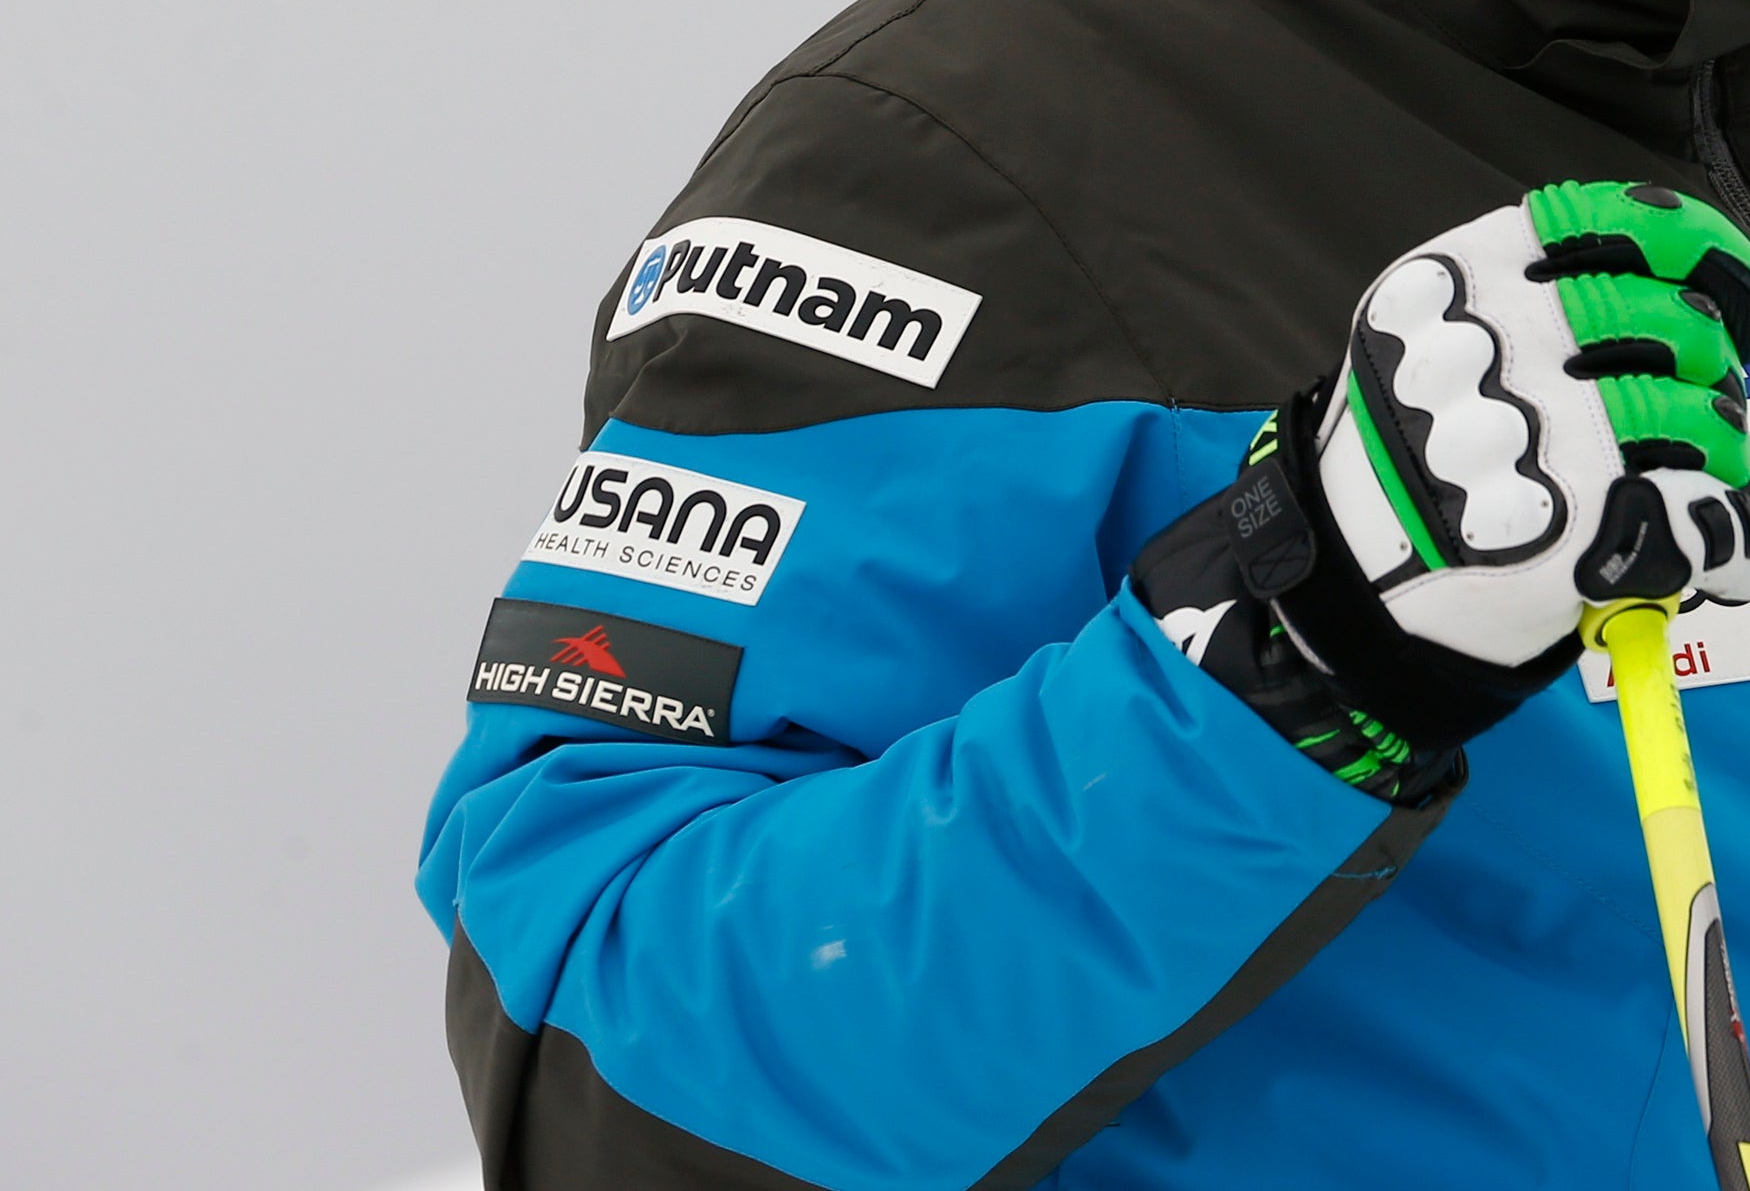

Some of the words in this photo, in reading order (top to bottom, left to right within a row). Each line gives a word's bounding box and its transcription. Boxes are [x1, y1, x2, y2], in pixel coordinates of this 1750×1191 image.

[652, 239, 944, 361] Putnam
[553, 465, 781, 566] USANA
[1231, 475, 1274, 518] ONE
[1238, 494, 1282, 538] SIZE
[534, 532, 610, 558] HEALTH
[618, 545, 758, 592] SCIENCES
[474, 661, 551, 695] HIGH
[551, 671, 715, 738] SIERRA
